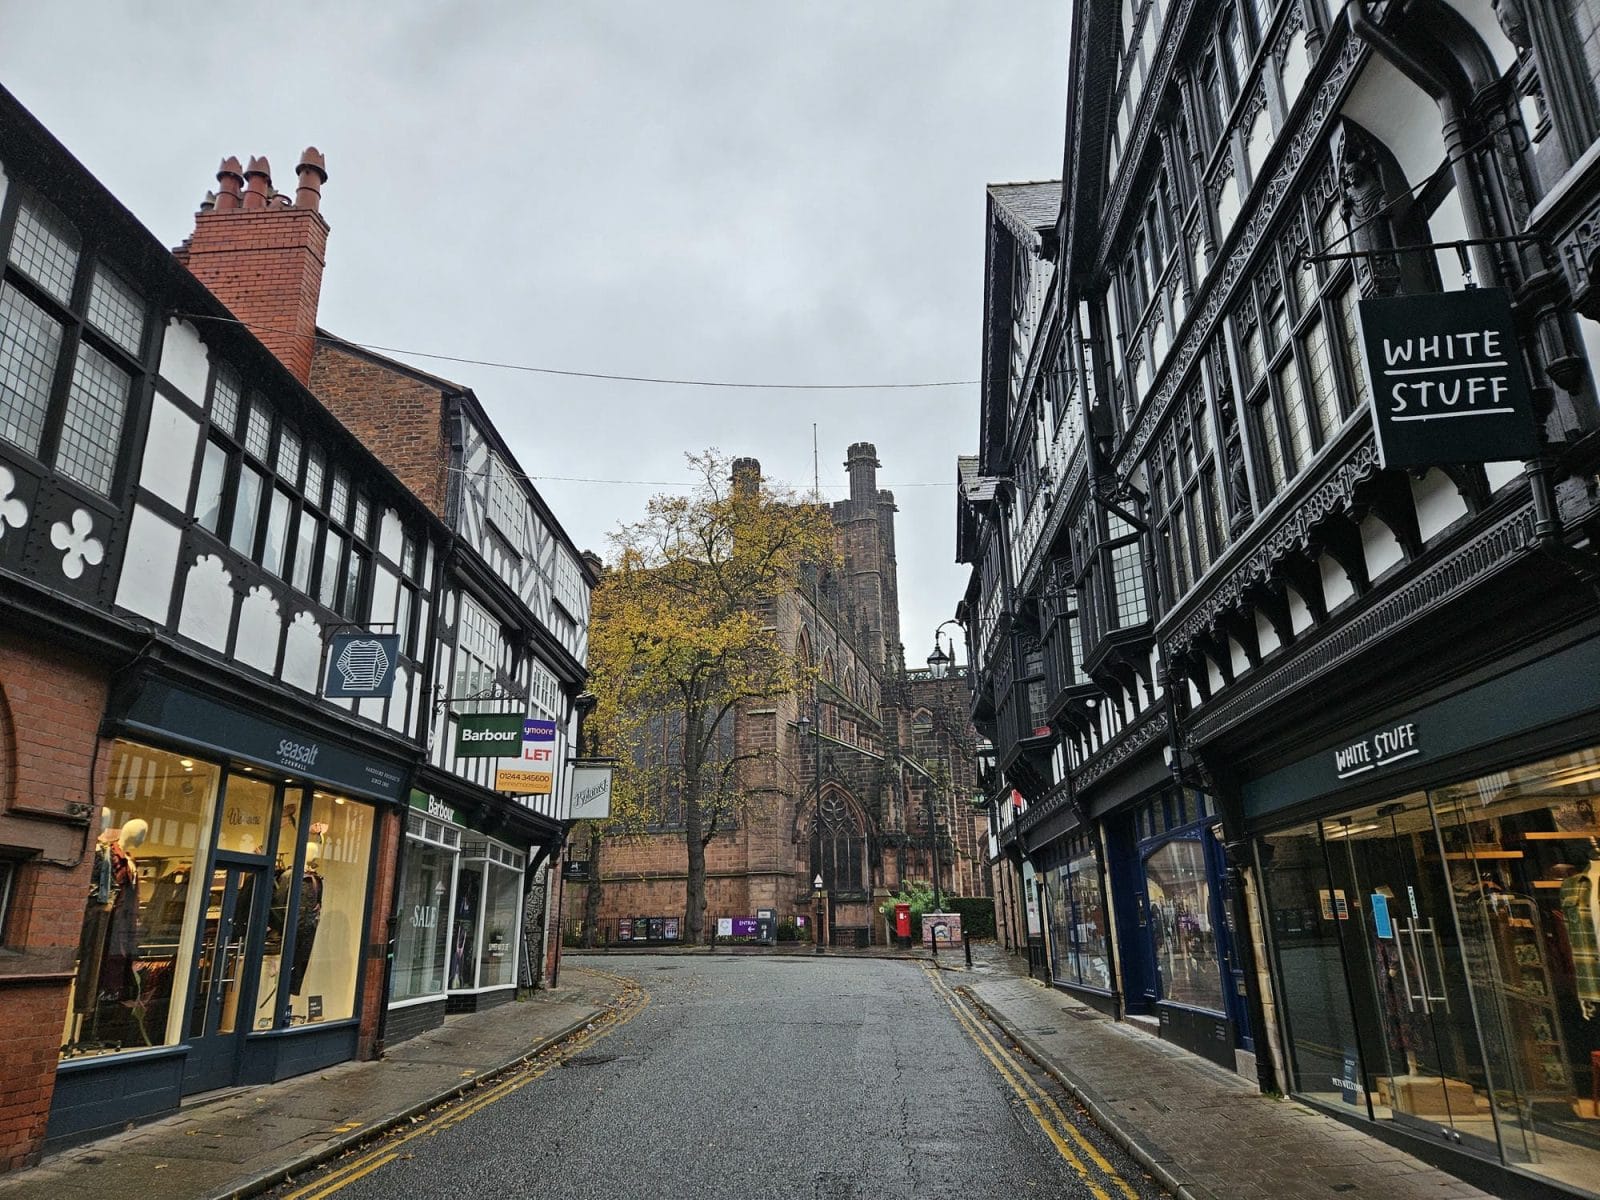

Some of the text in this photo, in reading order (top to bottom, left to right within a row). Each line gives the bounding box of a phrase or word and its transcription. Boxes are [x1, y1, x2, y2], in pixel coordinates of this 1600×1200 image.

[1383, 329, 1502, 366] WHITE
[1391, 376, 1508, 412] STUFF
[462, 728, 518, 742] Barbour
[524, 726, 553, 736] ymoore
[276, 739, 319, 765] seasalt
[525, 748, 552, 761] LET
[1335, 723, 1415, 772] WHITE STUFF
[499, 773, 550, 783] 01244 345600
[428, 794, 454, 823] Barbour
[410, 904, 437, 928] SALE
